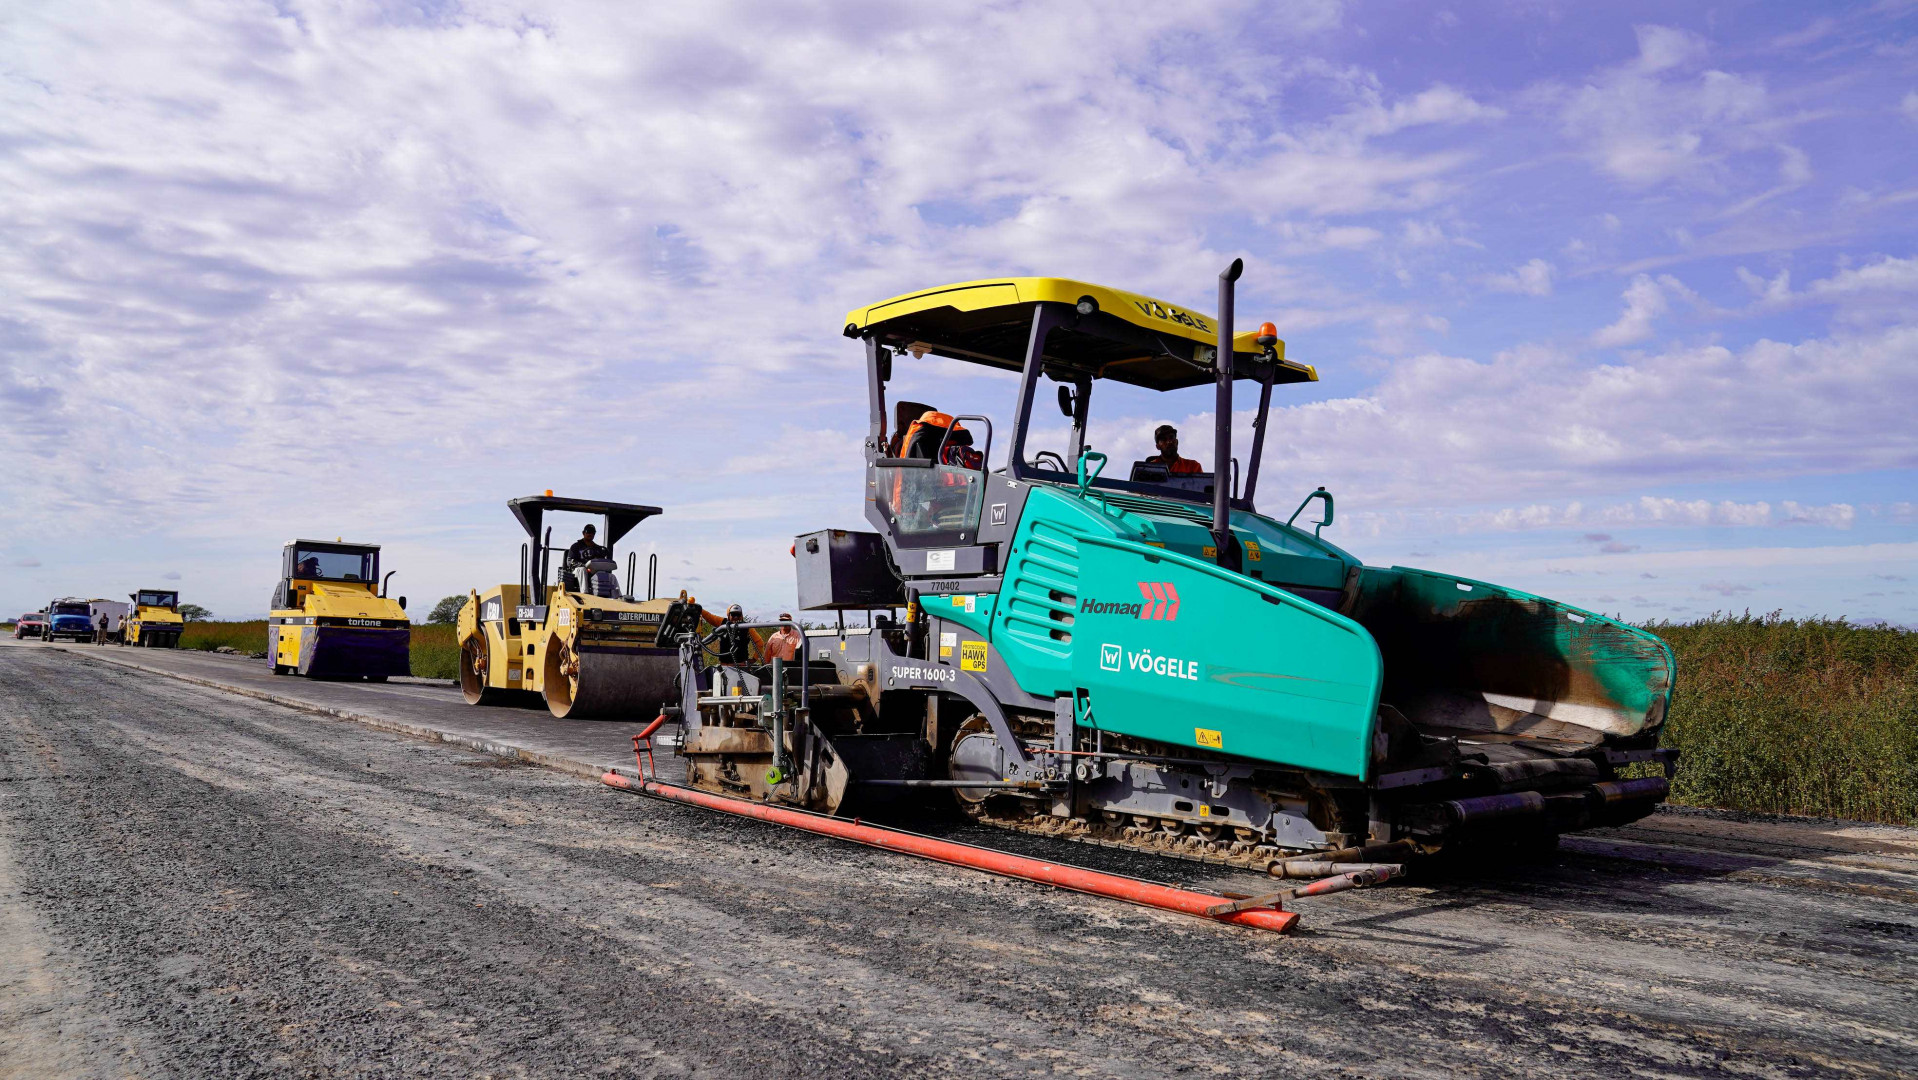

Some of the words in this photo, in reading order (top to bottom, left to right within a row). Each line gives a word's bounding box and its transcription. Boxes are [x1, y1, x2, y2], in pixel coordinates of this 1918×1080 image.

[1134, 301, 1212, 333] VÖGELE
[931, 581, 960, 591] 770402
[1080, 598, 1142, 620] Homaq
[347, 618, 382, 627] tortone
[618, 612, 660, 622] CATERPILLAR
[962, 649, 986, 661] HAWK
[972, 660, 986, 670] GPS
[1127, 648, 1199, 681] VÖGELE
[892, 666, 922, 680] SUPER
[922, 668, 956, 682] 1600-3
